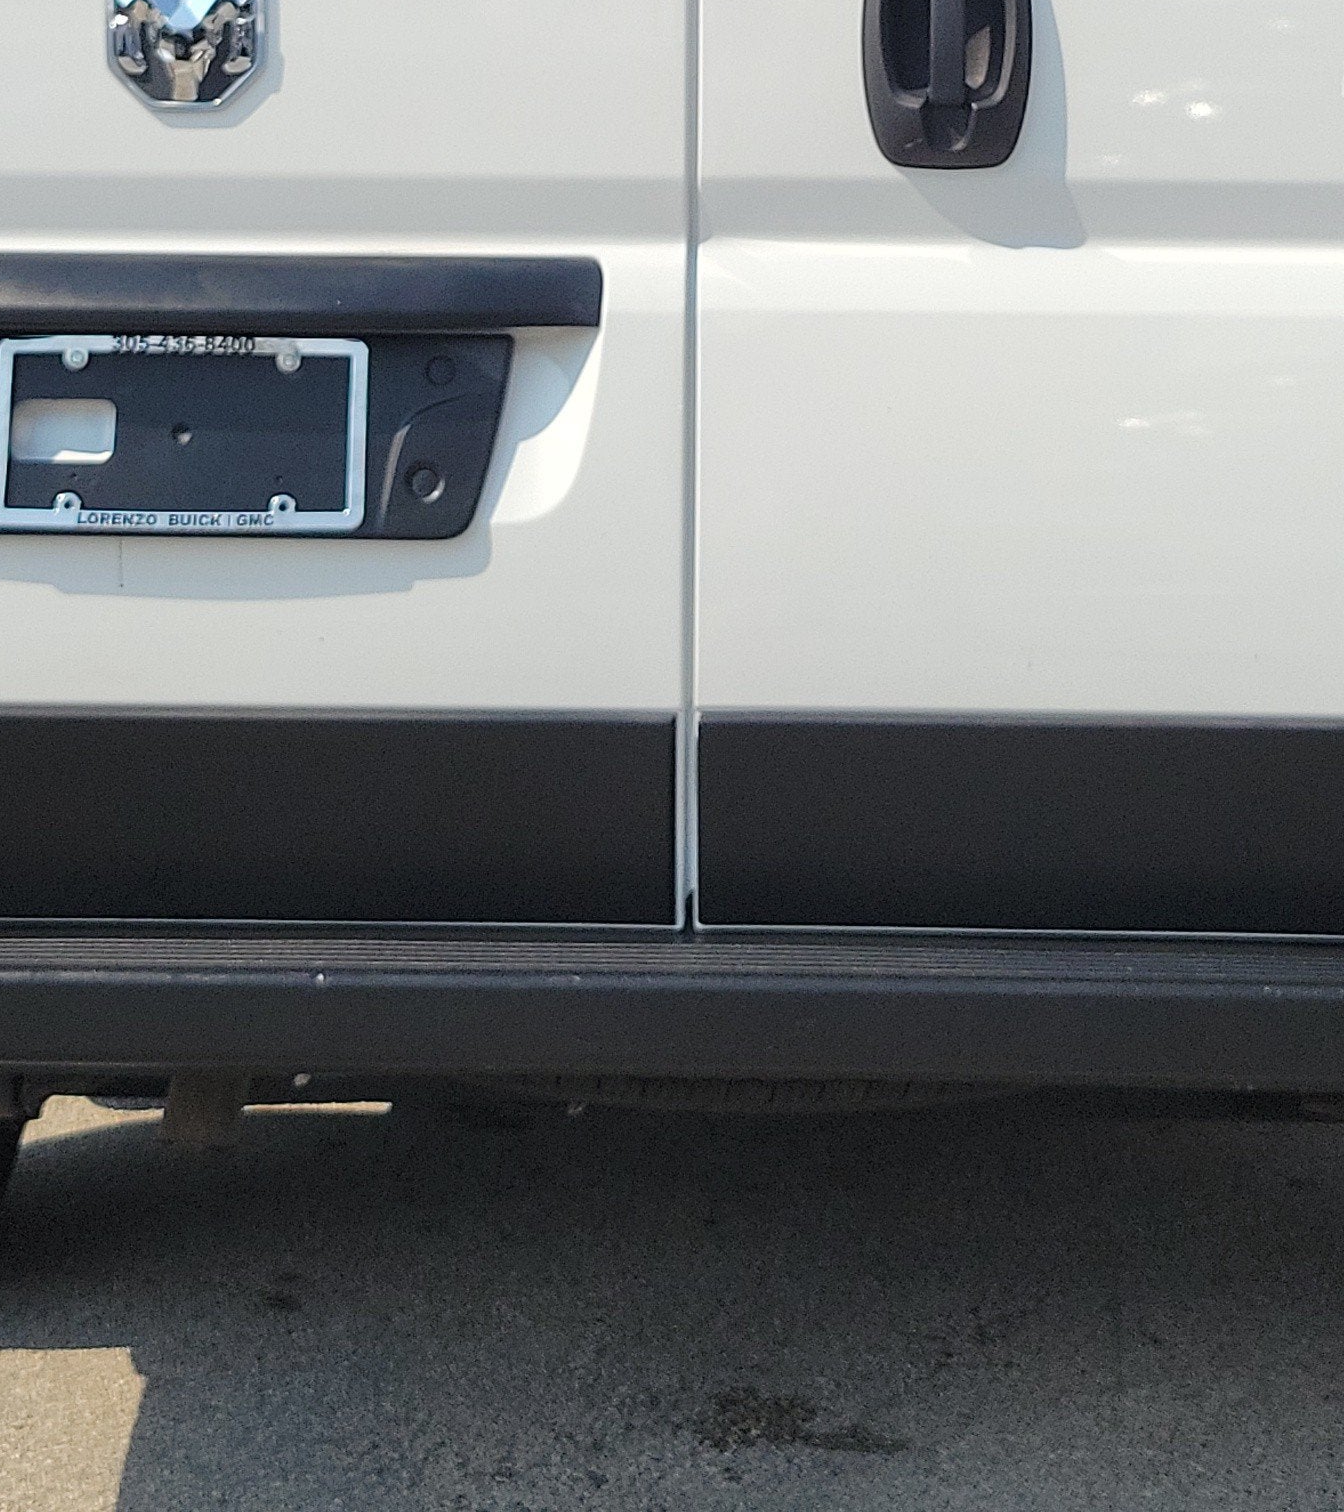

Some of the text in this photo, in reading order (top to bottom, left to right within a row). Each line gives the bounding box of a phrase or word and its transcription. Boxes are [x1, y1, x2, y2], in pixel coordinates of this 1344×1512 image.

[77, 513, 274, 526] LORENZO BUICK GMC
